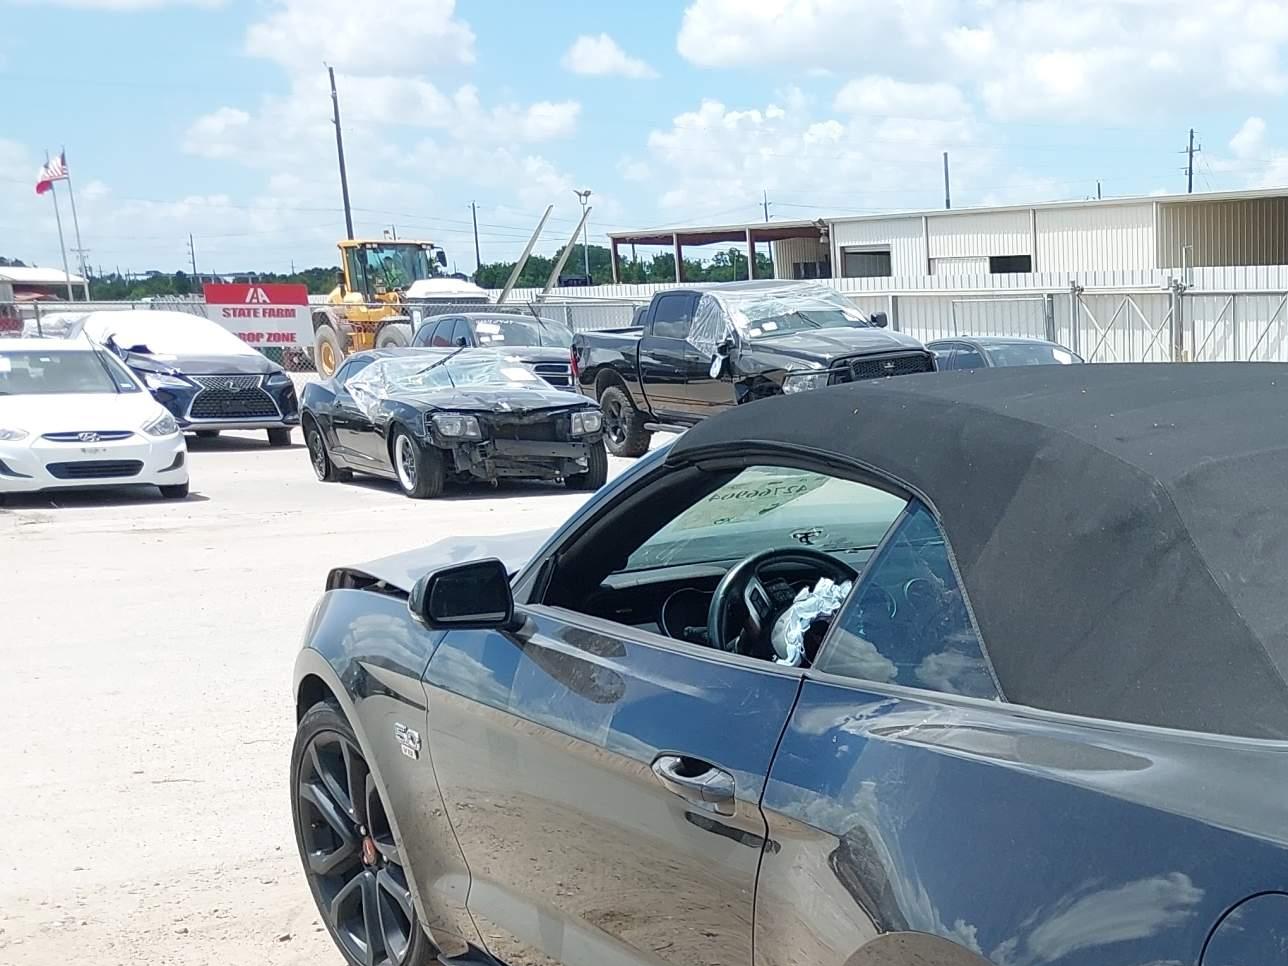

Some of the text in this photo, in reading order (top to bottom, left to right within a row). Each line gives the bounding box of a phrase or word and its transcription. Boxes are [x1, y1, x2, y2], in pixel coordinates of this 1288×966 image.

[222, 307, 297, 318] STATE FARM
[266, 332, 297, 343] ZONE
